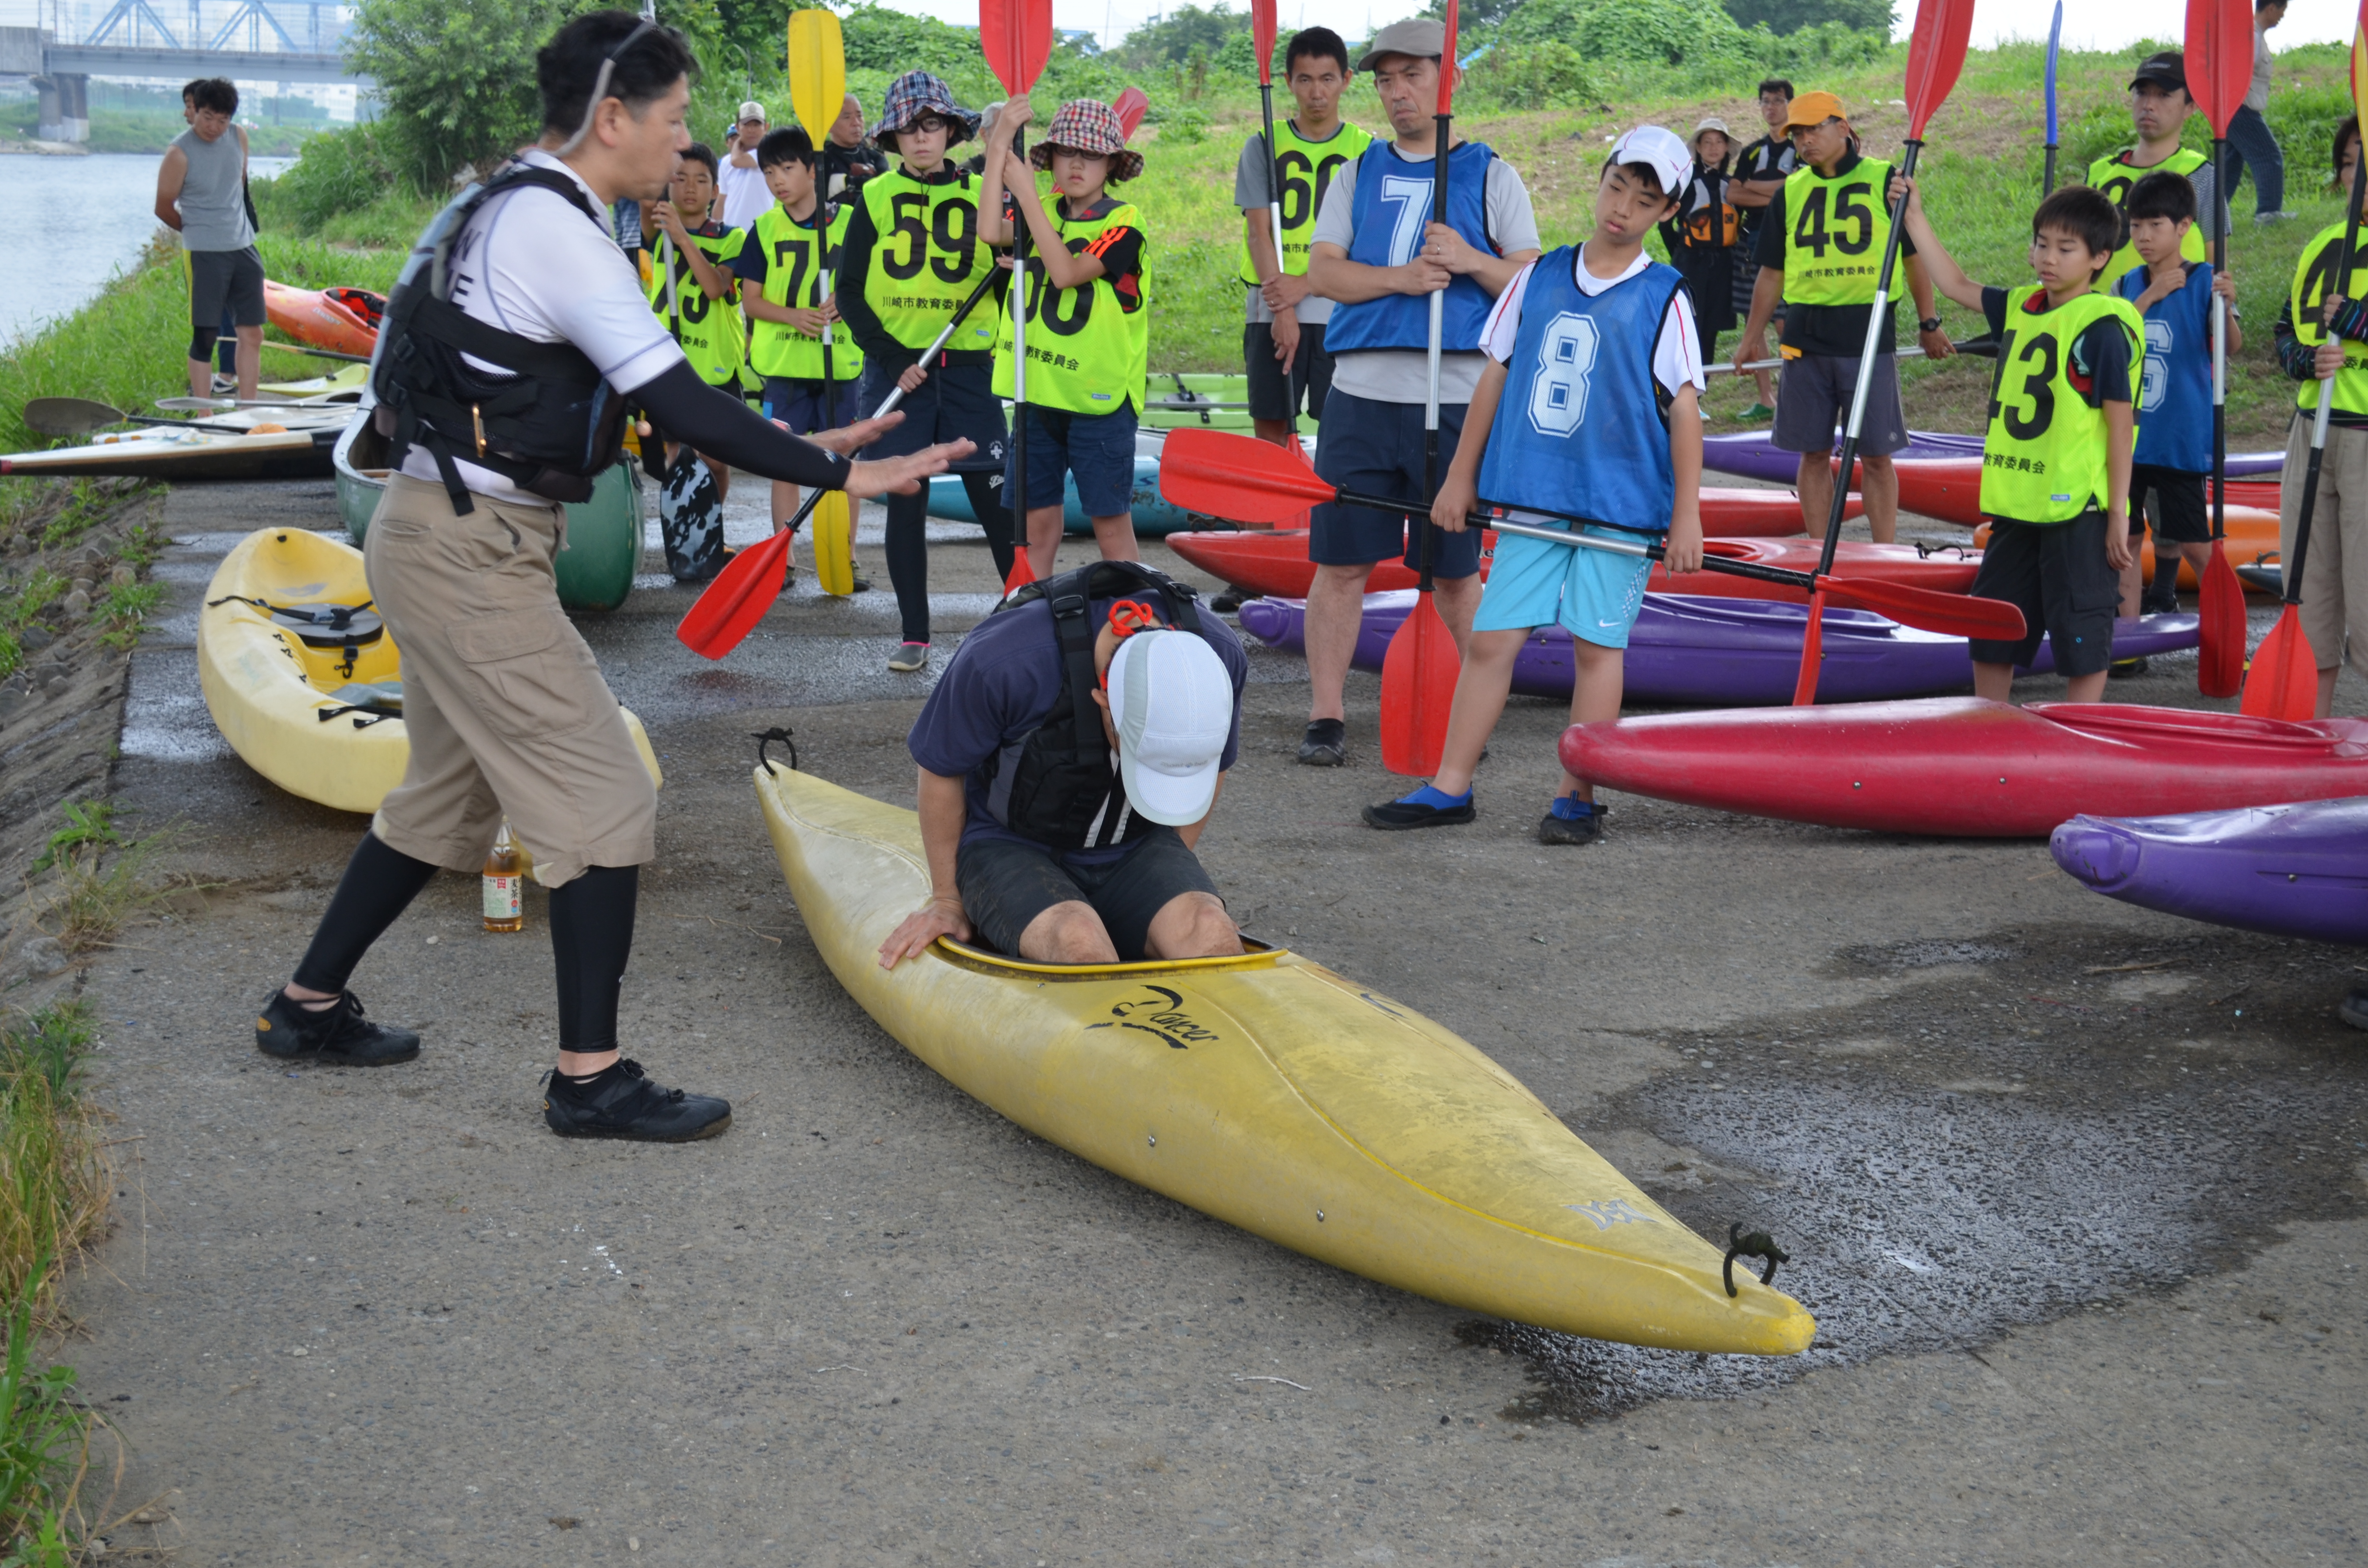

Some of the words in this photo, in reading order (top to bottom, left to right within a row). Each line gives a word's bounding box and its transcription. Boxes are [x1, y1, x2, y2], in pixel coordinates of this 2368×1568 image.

[882, 192, 978, 283] 59
[1381, 174, 1435, 267] 7
[1794, 182, 1873, 258] 45
[652, 244, 722, 324] 75
[882, 296, 974, 312] 川崎市教育委員
[1527, 310, 1600, 439] 8
[1985, 328, 2058, 441] 43
